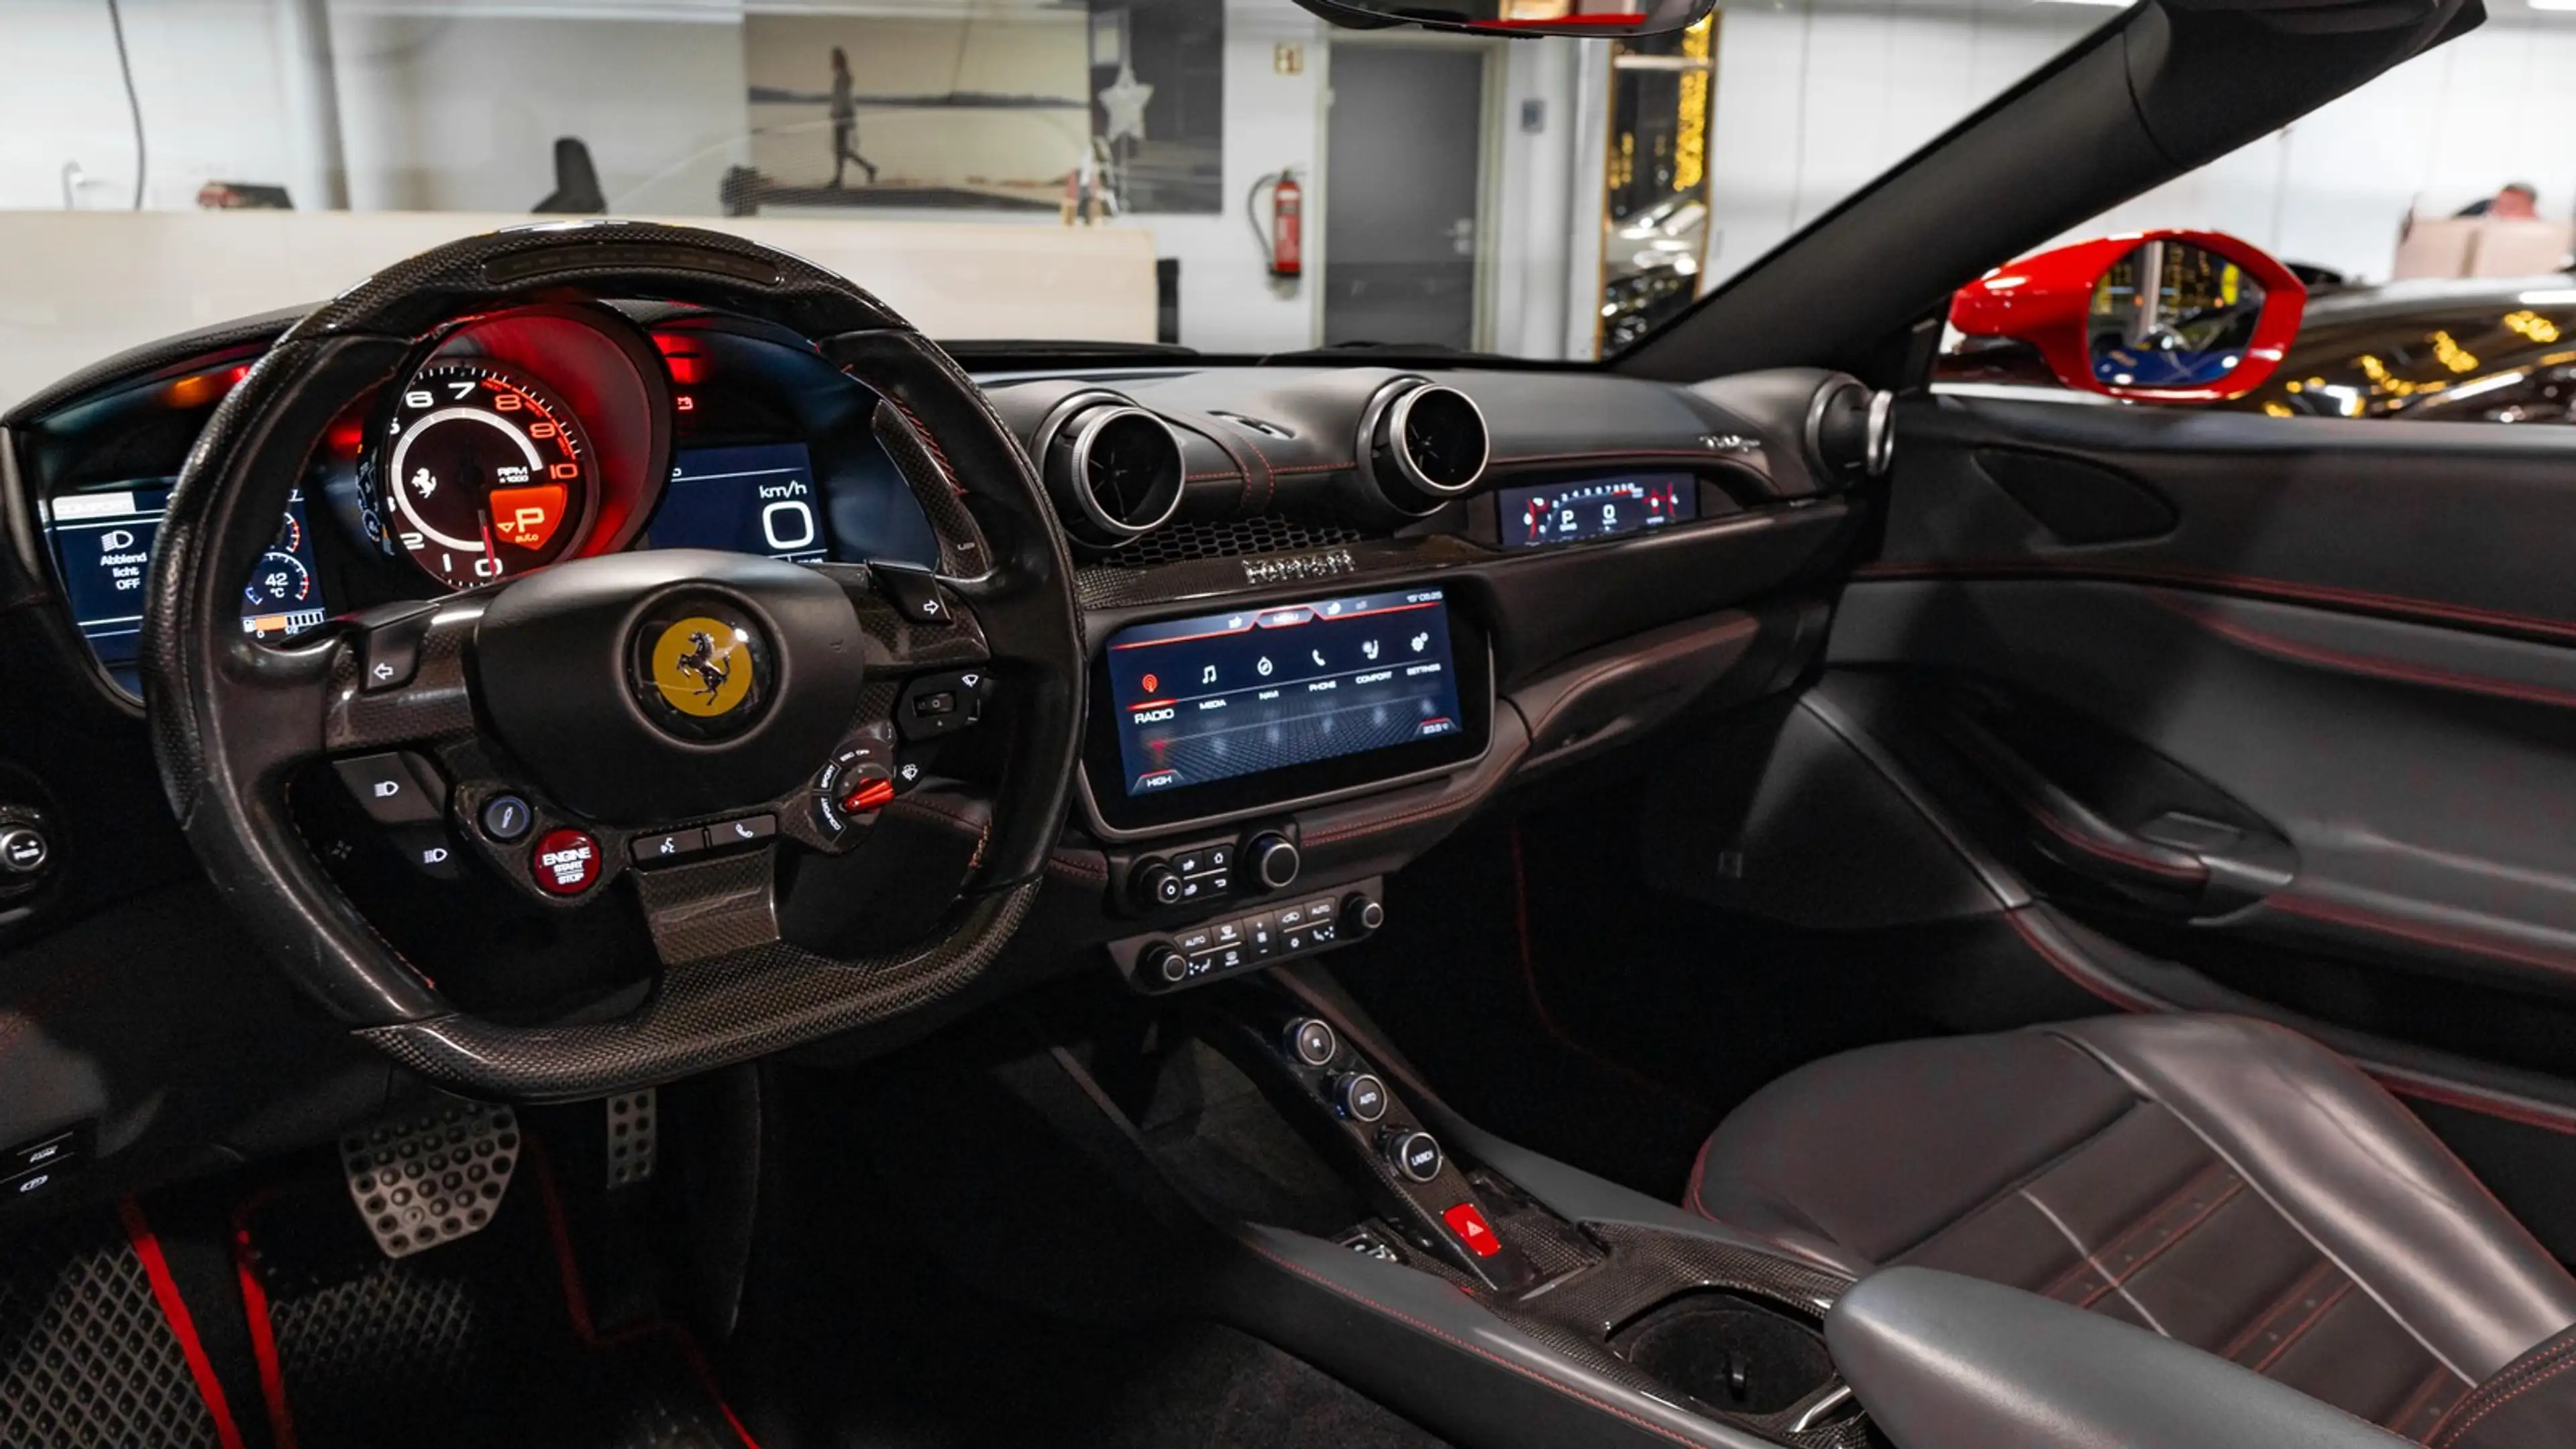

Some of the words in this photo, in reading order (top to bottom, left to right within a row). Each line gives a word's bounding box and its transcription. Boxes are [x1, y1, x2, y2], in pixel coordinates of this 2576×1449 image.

[447, 381, 476, 400] 7
[405, 390, 434, 408] 6
[494, 394, 523, 411] 8
[529, 422, 556, 439] 9
[549, 464, 579, 479] 10
[759, 480, 808, 498] km/h
[515, 507, 545, 533] P
[763, 500, 814, 549] 0
[400, 532, 425, 550] 2
[515, 534, 539, 543] auto
[100, 552, 148, 567] Abblend
[113, 566, 140, 578] licht
[474, 557, 503, 578] 0
[115, 577, 141, 591] OFF
[265, 572, 289, 586] 42
[1355, 671, 1392, 684] COMFORT
[1309, 681, 1336, 692] PHONE
[1199, 699, 1227, 710] MEDIA
[1134, 708, 1175, 724] RADIO
[820, 764, 836, 789] SPORT
[542, 847, 592, 867] ENGINE
[553, 859, 584, 873] START
[557, 872, 584, 885] STOP
[1311, 903, 1331, 916] AUTO
[1185, 934, 1205, 948] AUTO
